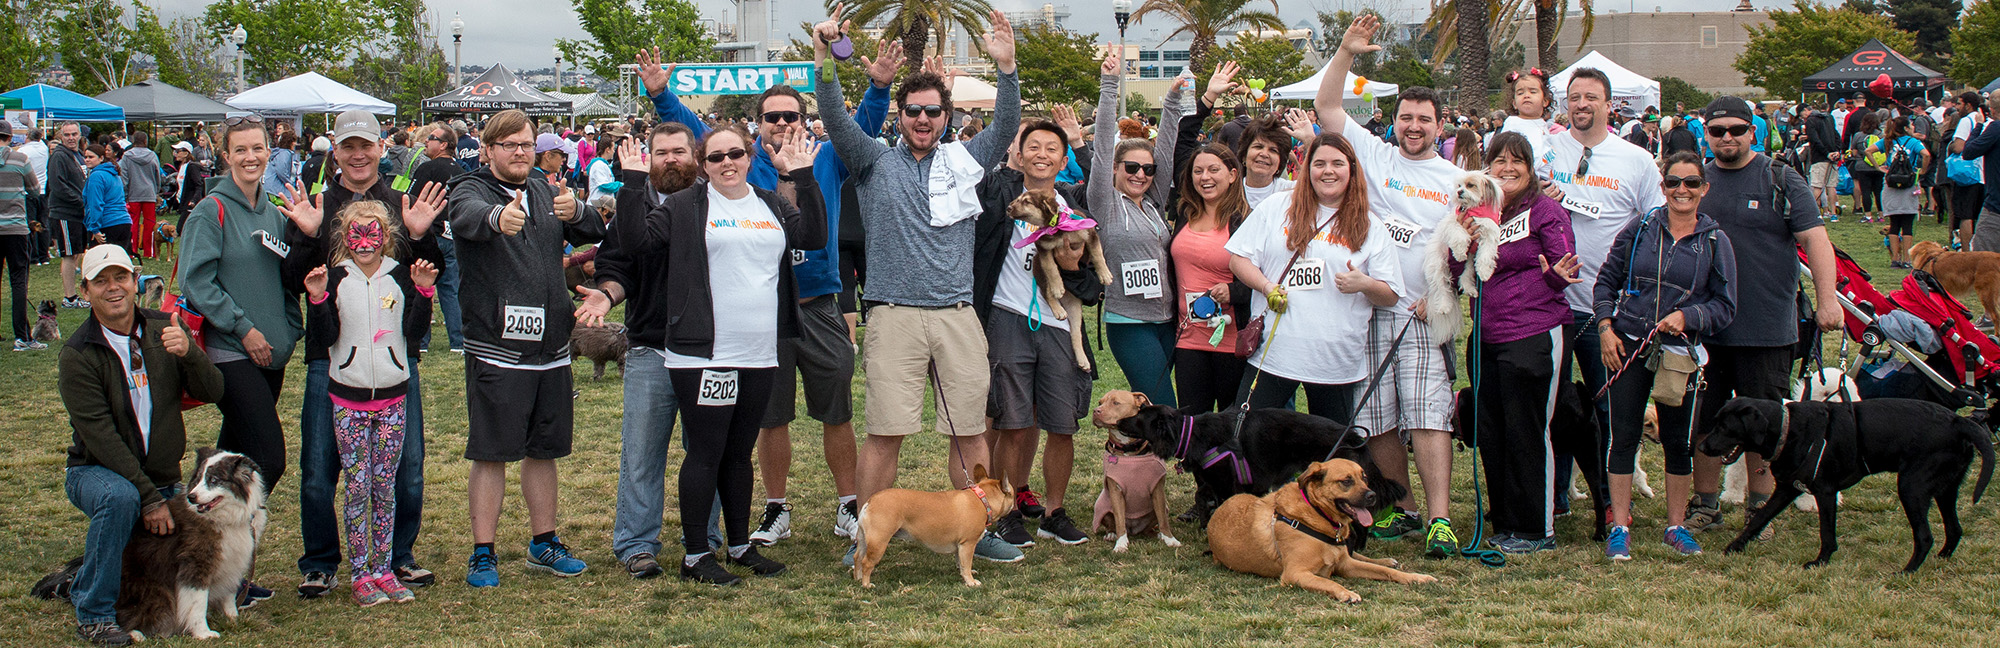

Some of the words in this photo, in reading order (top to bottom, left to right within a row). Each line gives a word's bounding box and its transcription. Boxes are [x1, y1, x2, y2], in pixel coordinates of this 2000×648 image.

[676, 67, 779, 92] START
[787, 67, 808, 80] WALK
[456, 81, 505, 96] PGS
[1828, 80, 1912, 90] CYCLAR
[1553, 169, 1572, 185] WALK
[1572, 173, 1586, 186] FOR
[1586, 175, 1620, 191] ANIMALS
[1403, 185, 1416, 198] FOR
[1416, 188, 1449, 206] ANIMALS
[714, 219, 738, 228] WALK
[1500, 218, 1526, 241] 2621
[1125, 267, 1159, 289] 3086
[1288, 266, 1321, 287] 2668
[506, 314, 543, 336] 2493
[702, 379, 736, 400] 5202
